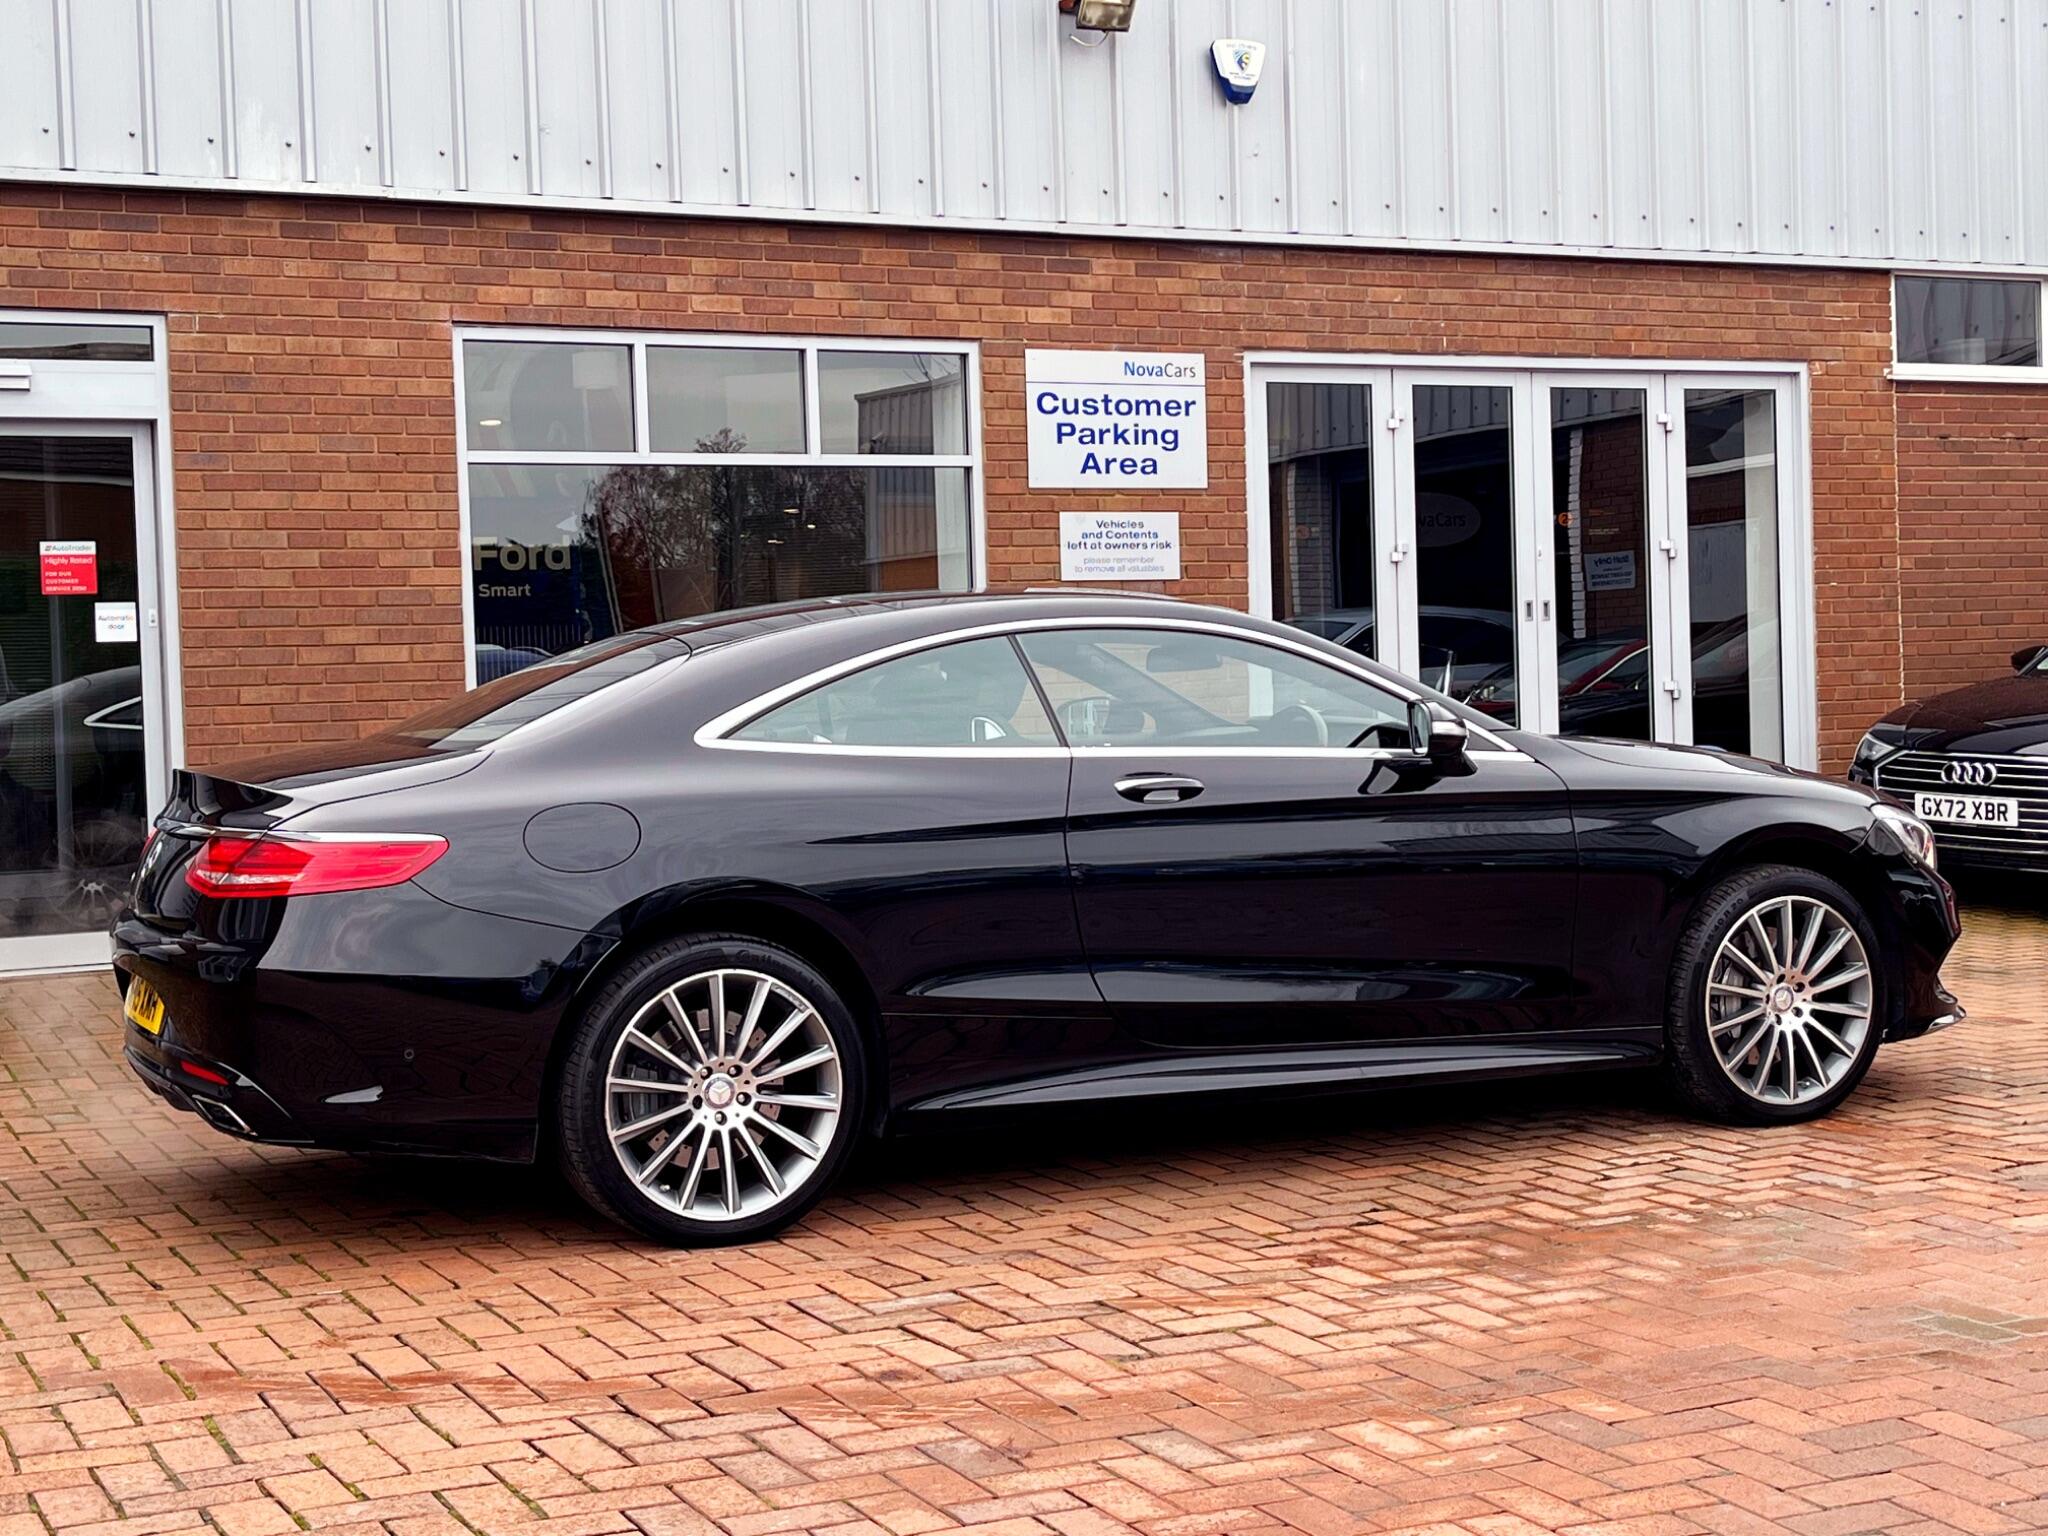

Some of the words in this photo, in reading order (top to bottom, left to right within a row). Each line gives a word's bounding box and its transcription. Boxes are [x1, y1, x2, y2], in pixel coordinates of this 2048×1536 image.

[1123, 361, 1197, 378] NovaCars
[1036, 391, 1197, 417] Customer
[1056, 422, 1180, 451] Parking
[1080, 452, 1158, 475] Area
[1096, 519, 1145, 529] Vehicles
[1067, 540, 1088, 550] left
[1090, 540, 1102, 550] at
[1104, 541, 1148, 550] owners
[1150, 540, 1172, 550] risk
[1081, 530, 1103, 540] and
[1105, 530, 1159, 540] Contents
[472, 534, 572, 571] Ford
[478, 583, 531, 598] Smart
[1921, 797, 1967, 819] GX72
[1971, 800, 2009, 822] XBR
